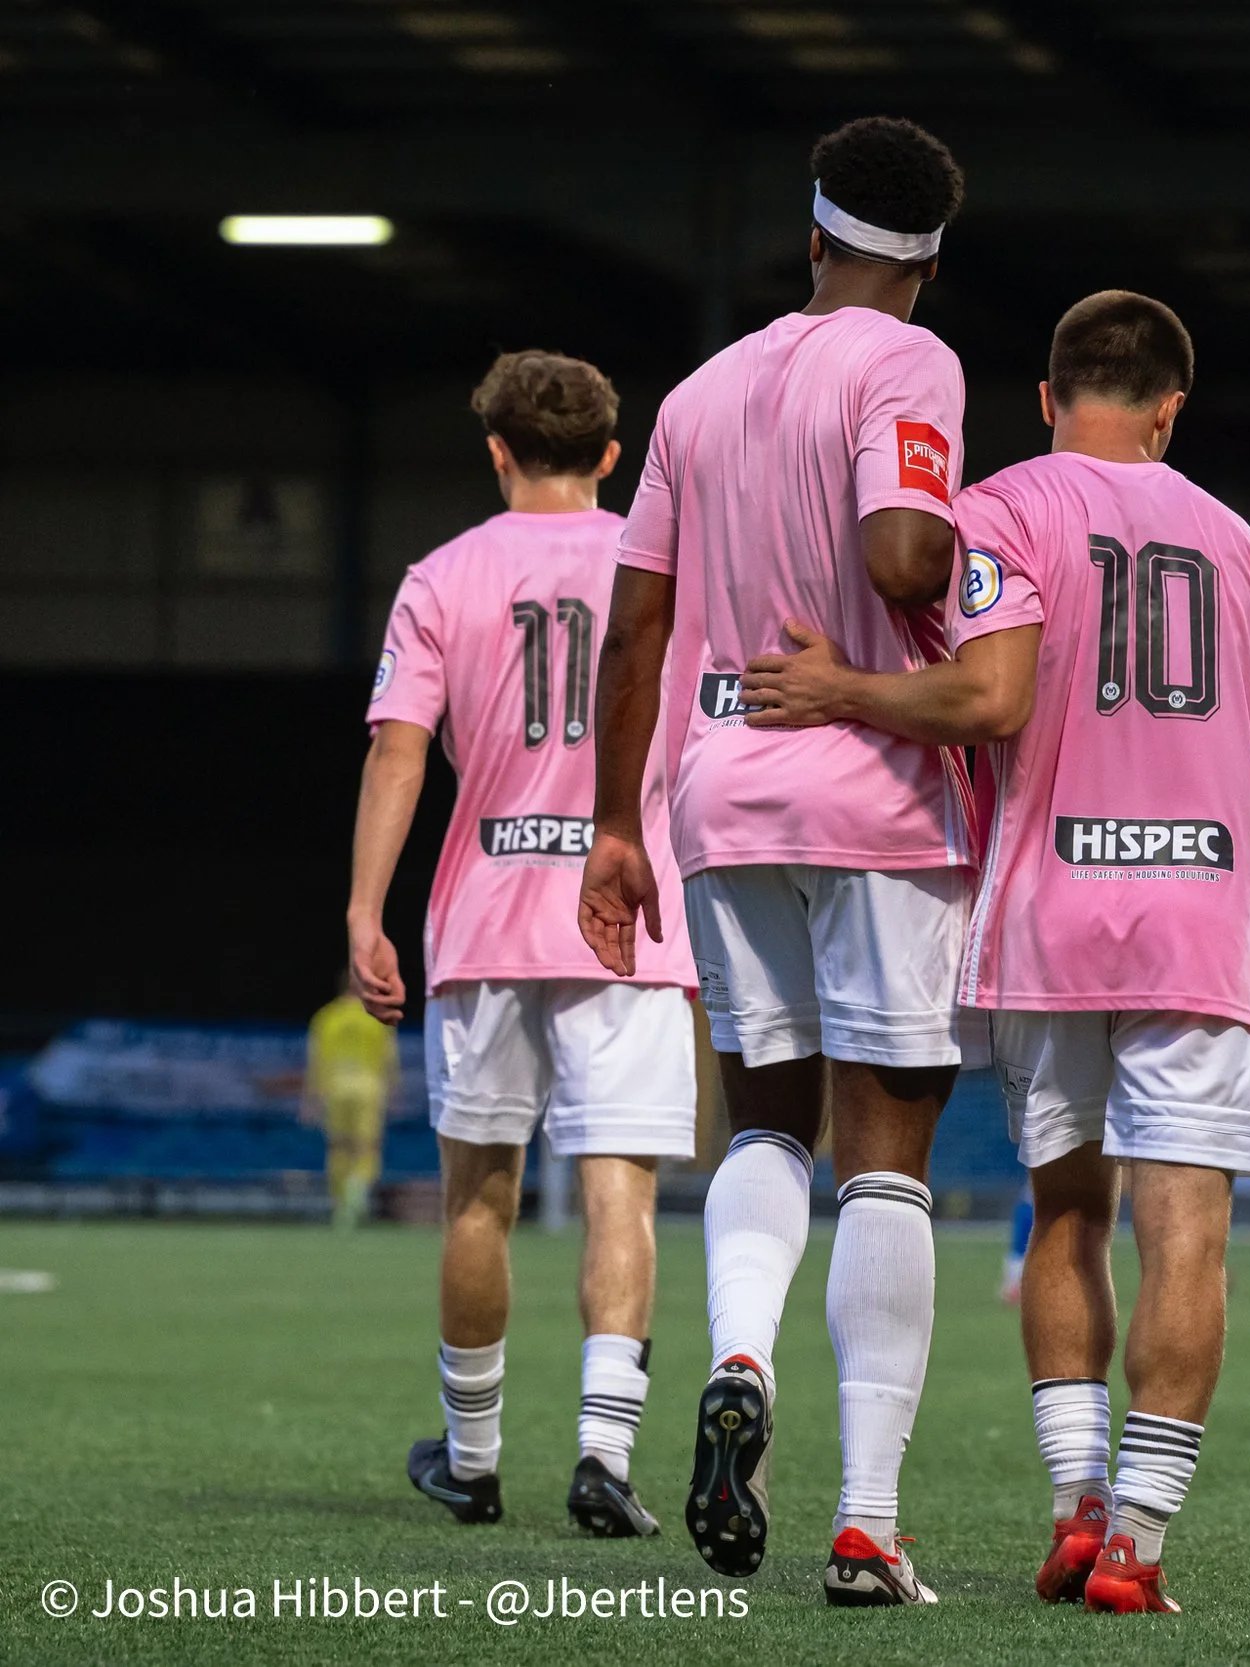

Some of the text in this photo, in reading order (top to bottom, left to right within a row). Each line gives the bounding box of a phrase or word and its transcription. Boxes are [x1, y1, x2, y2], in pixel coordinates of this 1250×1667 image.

[512, 598, 597, 751] 11
[1089, 533, 1221, 722] 10
[1071, 870, 1089, 879] LIFE
[1093, 870, 1124, 879] SAFETY
[1136, 870, 1172, 879] HOUSING
[1175, 870, 1220, 882] SOLUTIONS
[1072, 820, 1220, 863] HiSPEC
